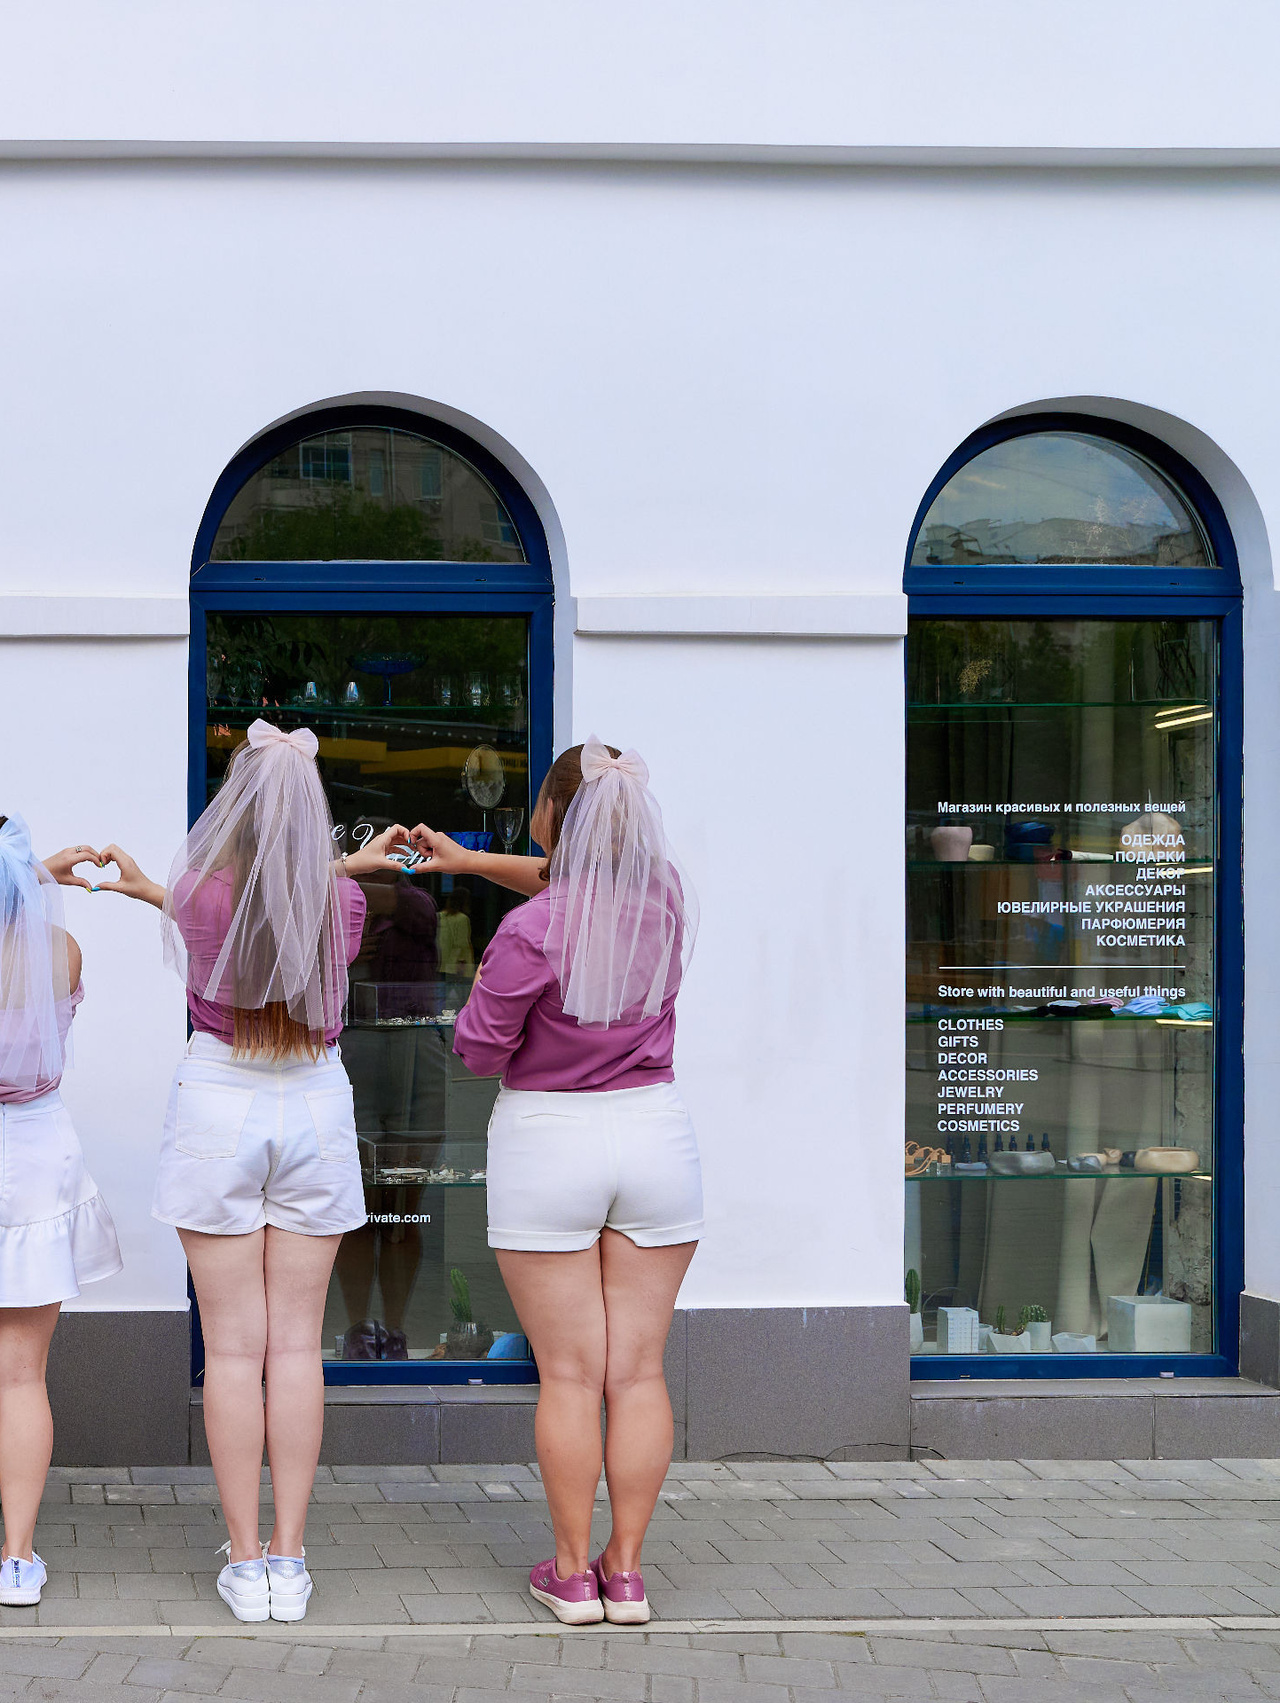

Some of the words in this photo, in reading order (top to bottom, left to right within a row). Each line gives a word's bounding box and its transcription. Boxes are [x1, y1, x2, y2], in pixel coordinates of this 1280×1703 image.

[938, 802, 991, 813] Магазин
[996, 803, 1060, 816] красивых
[1064, 804, 1071, 813] и
[1076, 804, 1140, 813] полезных
[1145, 801, 1185, 815] вещей
[1121, 835, 1185, 847] ОДЕЖДА
[1116, 851, 1185, 864] ПОДАРКИ
[1136, 868, 1185, 881] ДЕКОР
[1085, 885, 1185, 896] АКСЕССУАРЫ
[997, 902, 1091, 913] ЮВЕЛИРНЫЕ
[1096, 902, 1185, 913] УКРАШЕНИЯ
[1082, 918, 1185, 929] ПАРФЮМЕРИЯ
[1097, 936, 1185, 946] КОСМЕТИКА
[938, 986, 974, 998] Store
[977, 986, 1005, 998] with
[1009, 986, 1067, 998] beautiful
[1070, 986, 1095, 998] and
[1100, 986, 1140, 998] useful
[1144, 986, 1185, 999] things
[938, 1019, 1003, 1030] CLOTHES
[938, 1036, 978, 1047] GIFTS
[938, 1053, 987, 1064] DECOR
[938, 1070, 1038, 1081] ACCESSORIES
[938, 1087, 1003, 1098] JEWELRY
[938, 1104, 1024, 1114] PERFUMERY
[938, 1120, 1019, 1131] COSMETICS
